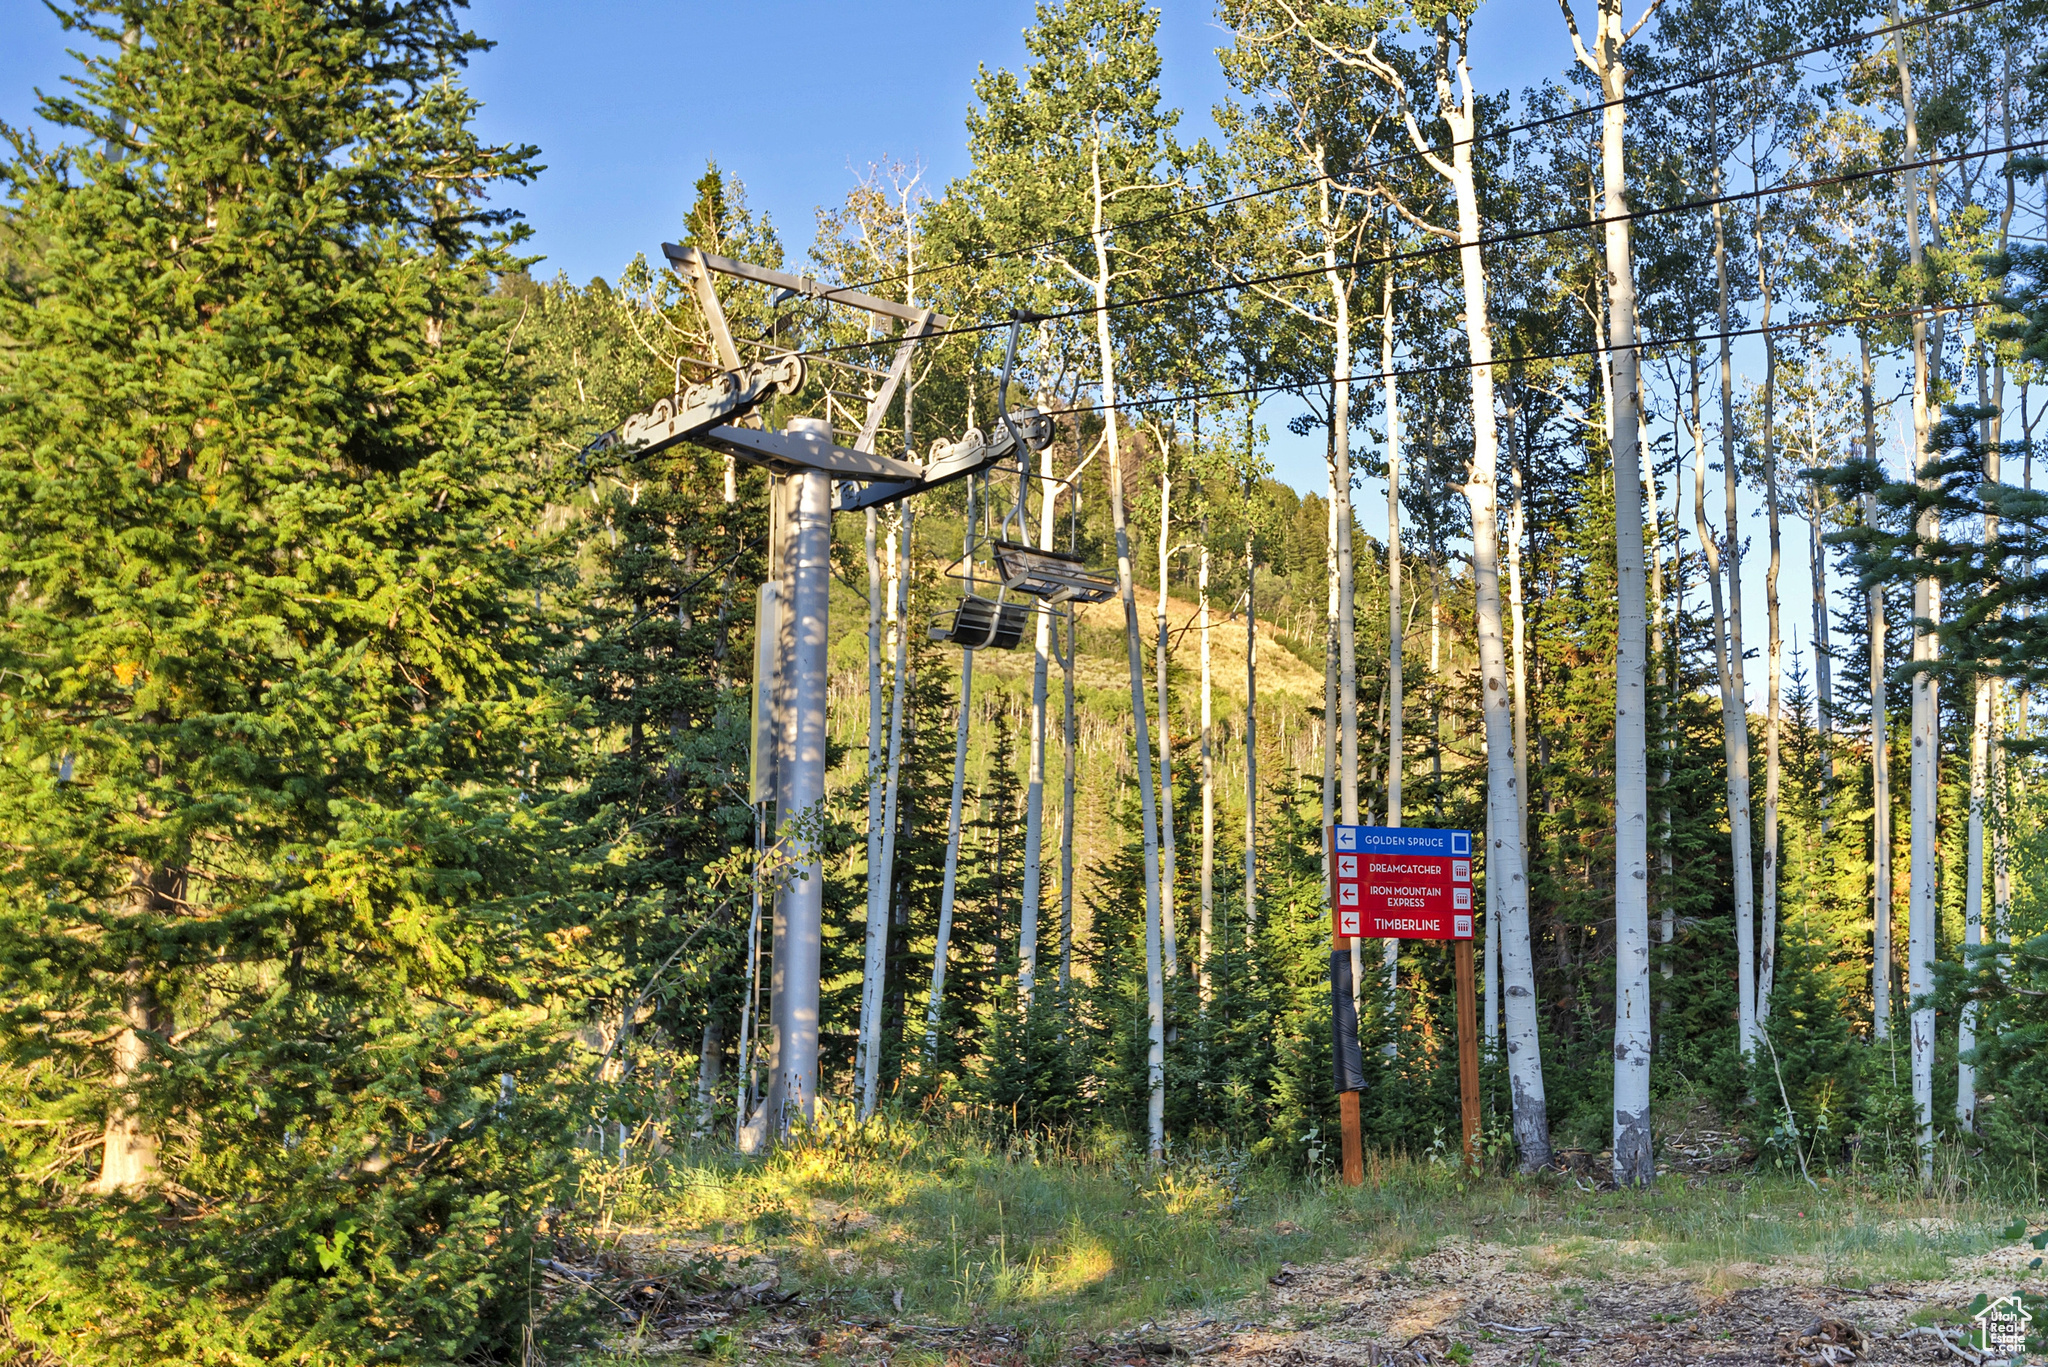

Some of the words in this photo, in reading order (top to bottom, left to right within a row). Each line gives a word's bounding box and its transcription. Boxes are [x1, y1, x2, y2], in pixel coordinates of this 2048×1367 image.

[1365, 835, 1405, 845] GOLDEN
[1407, 837, 1444, 847] SPRUCE
[1369, 863, 1442, 874] DREAMCATCHER
[1370, 886, 1393, 895] IRON
[1394, 887, 1442, 897] MOUNTAIN
[1387, 898, 1425, 907] EXPRESS
[1374, 918, 1441, 930] TIMBERLINE
